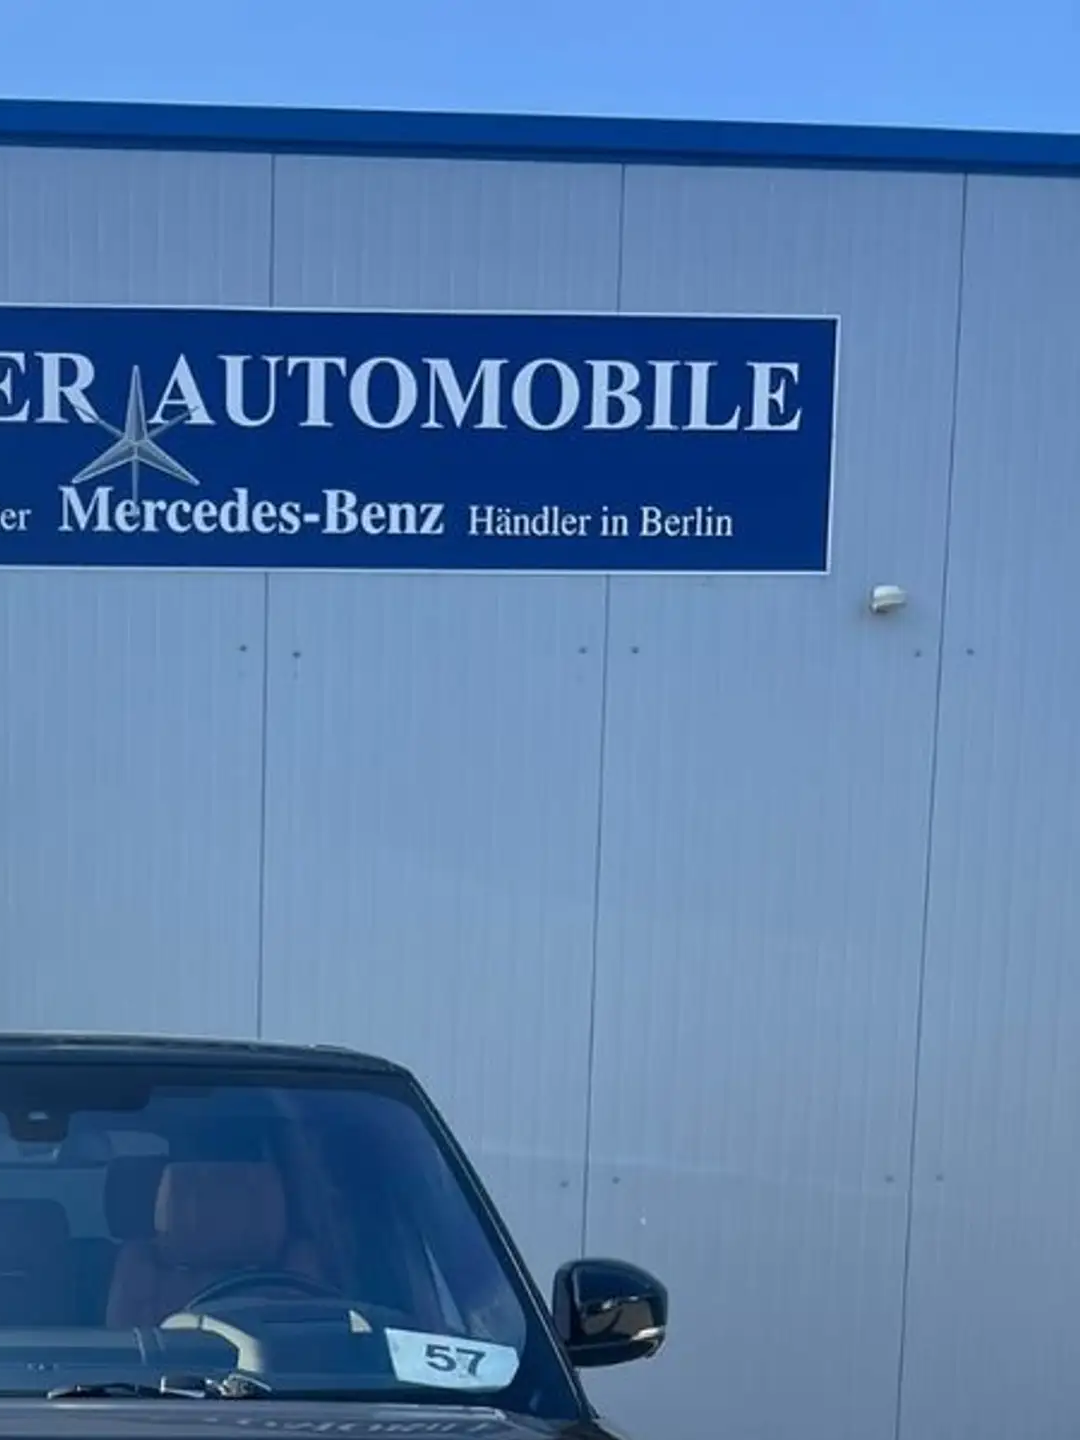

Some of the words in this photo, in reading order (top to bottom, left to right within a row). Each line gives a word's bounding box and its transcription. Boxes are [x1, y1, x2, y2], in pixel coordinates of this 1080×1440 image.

[148, 352, 803, 432] AUTOMOBILE
[58, 485, 444, 535] Mercedes-Benz
[467, 505, 591, 538] Händler
[601, 508, 628, 537] in
[639, 507, 733, 538] Berlin
[424, 1343, 486, 1378] 57
